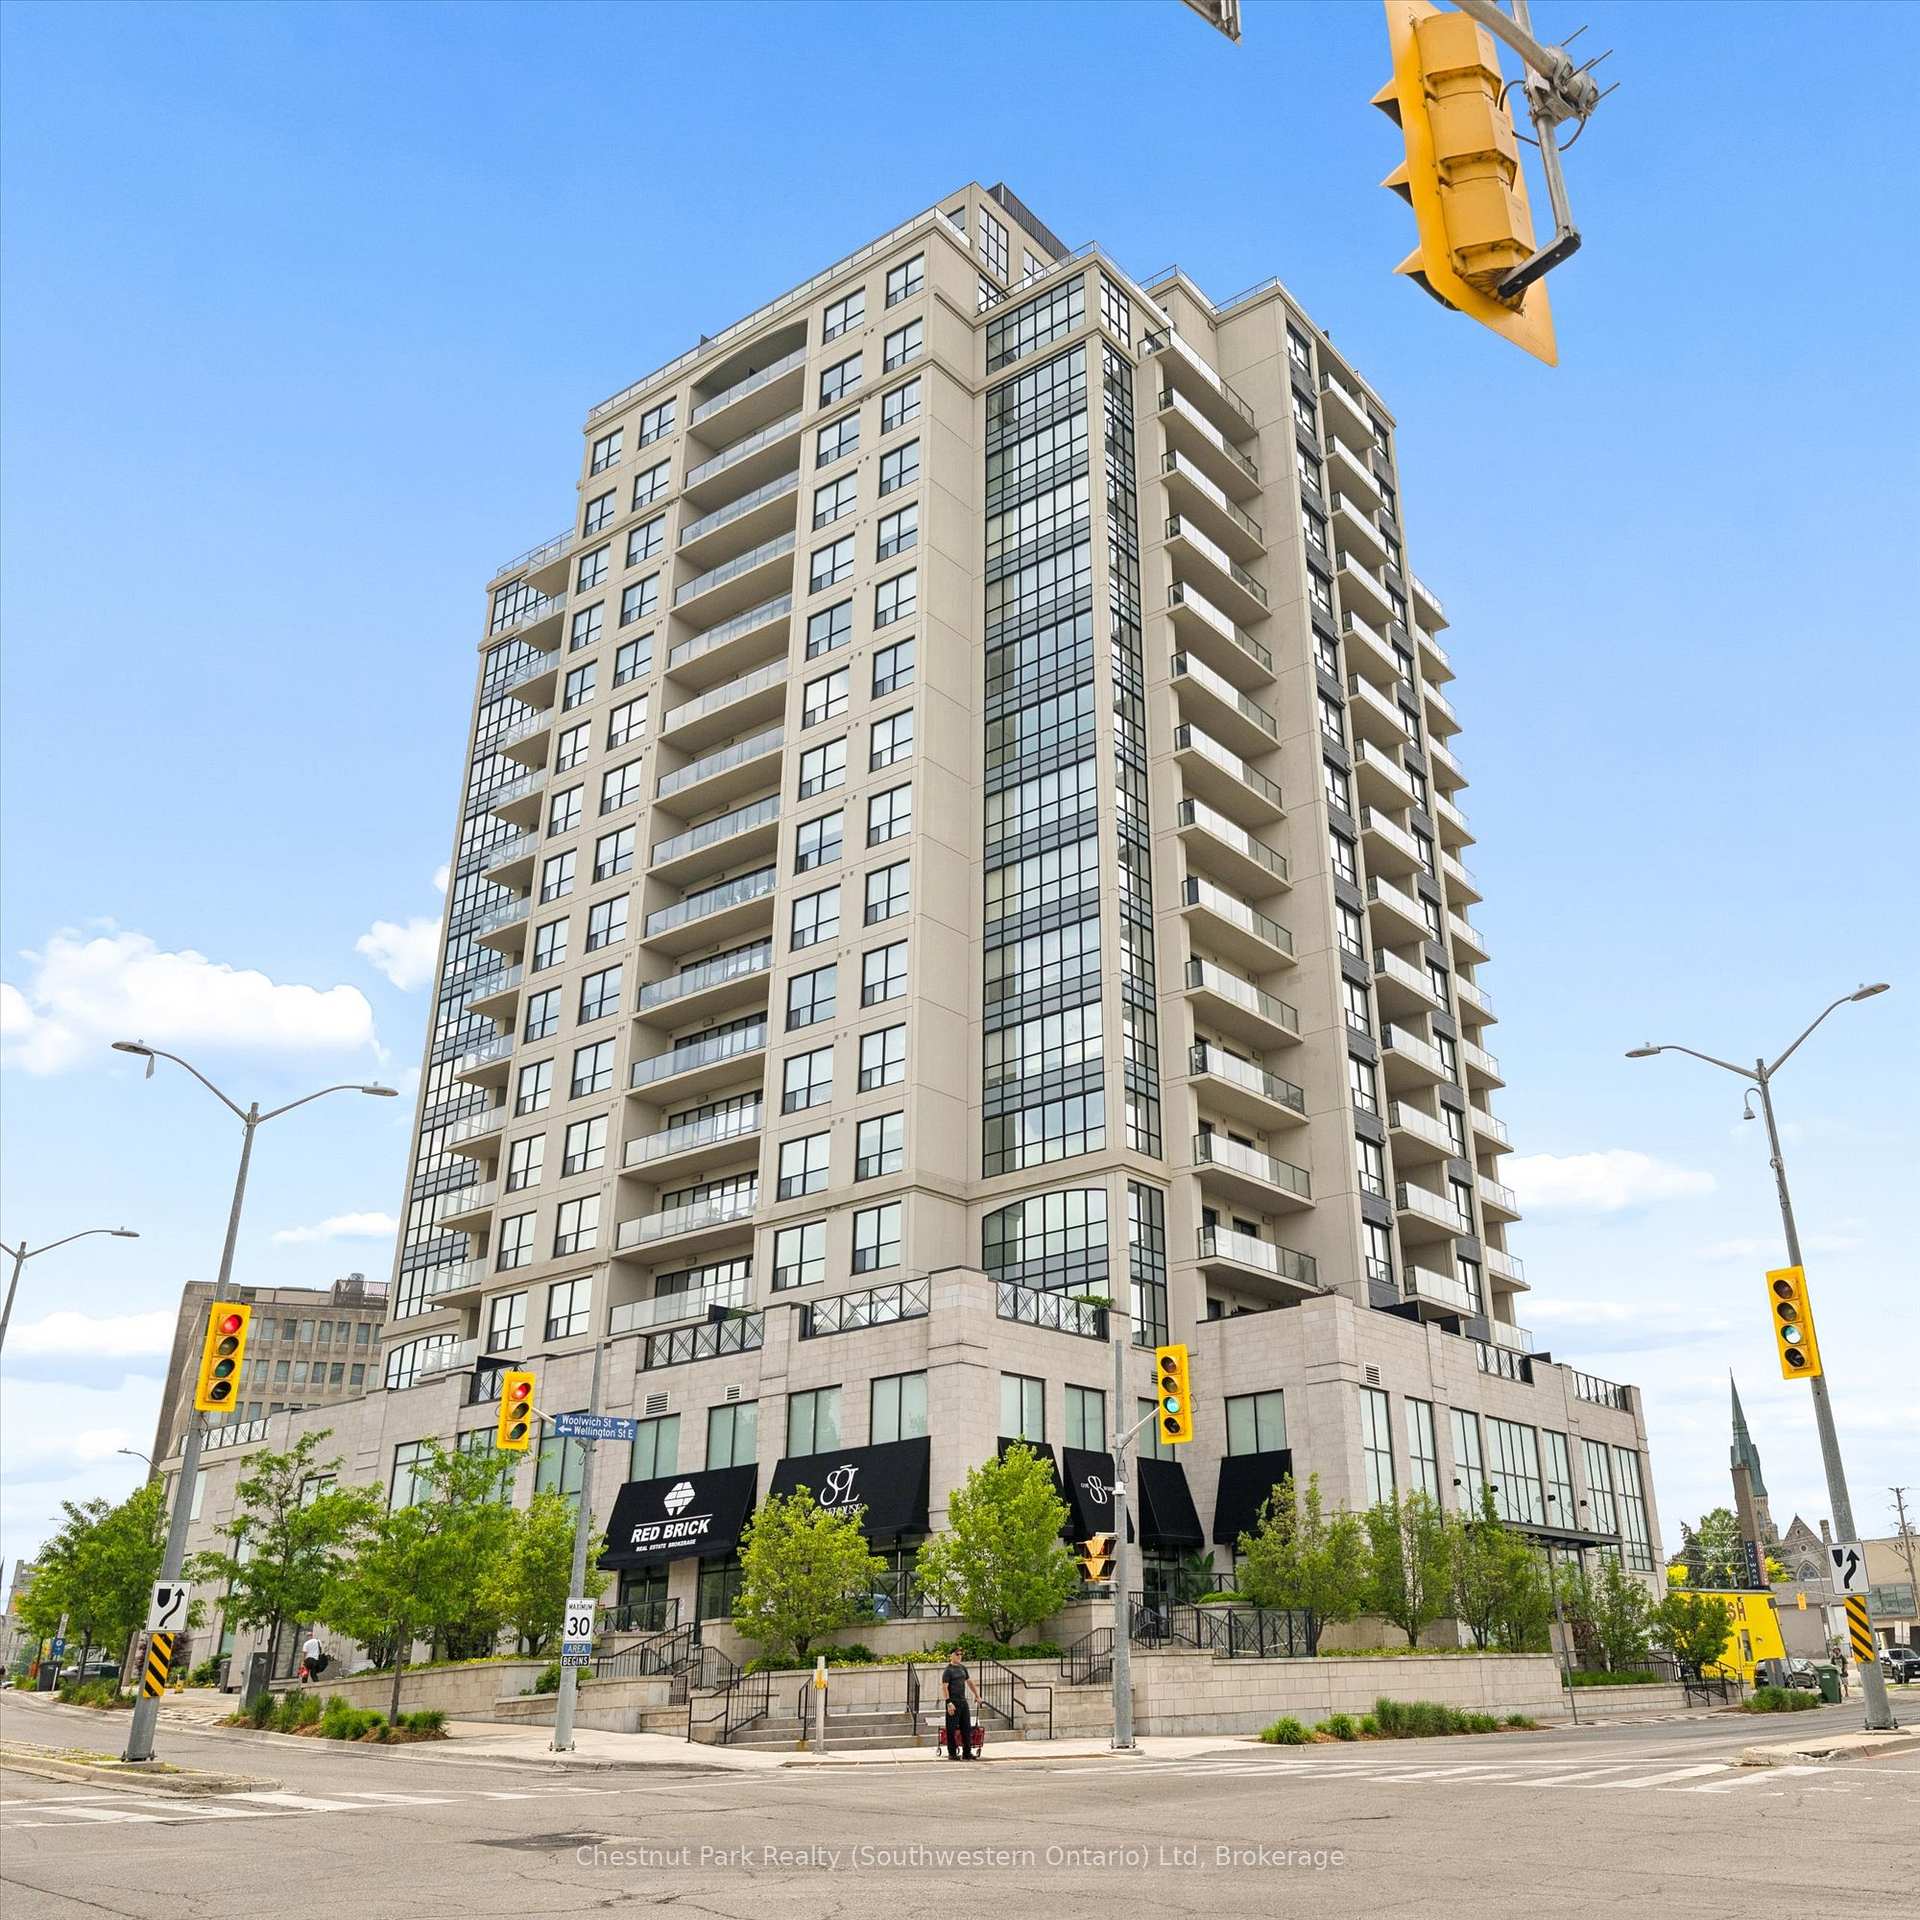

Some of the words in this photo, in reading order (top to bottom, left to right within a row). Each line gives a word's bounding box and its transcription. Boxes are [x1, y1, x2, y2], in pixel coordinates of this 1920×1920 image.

[562, 1415, 601, 1427] Woolwich
[603, 1418, 612, 1428] St
[574, 1426, 616, 1439] Wellington
[617, 1429, 626, 1438] St
[628, 1430, 634, 1438] E
[630, 1526, 660, 1543] RED
[662, 1518, 711, 1539] BRICK
[667, 1539, 697, 1549] BROKERAGE
[567, 1617, 590, 1636] 30
[567, 1644, 588, 1653] AREA
[562, 1656, 588, 1666] BEGINS
